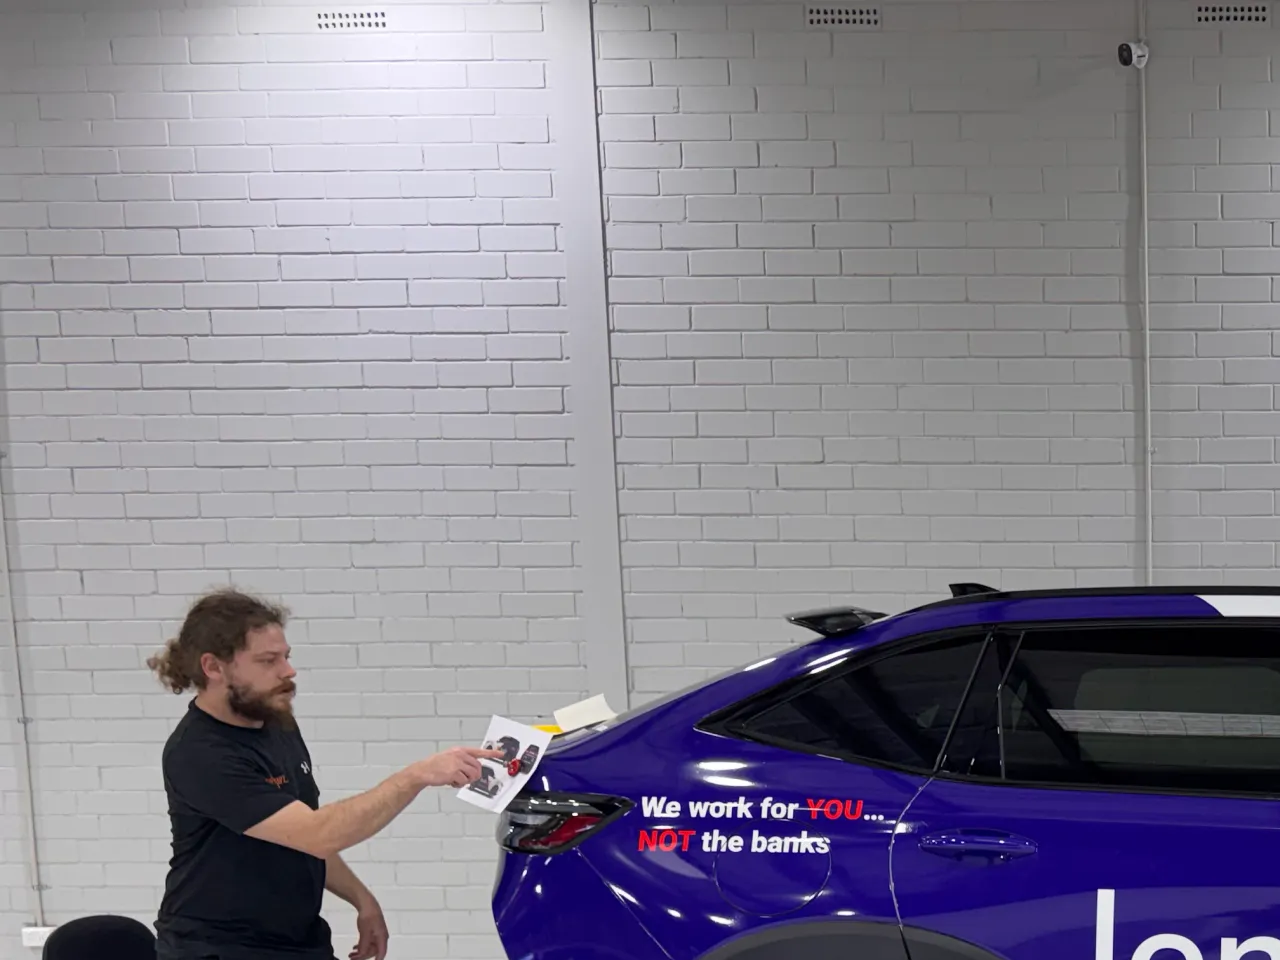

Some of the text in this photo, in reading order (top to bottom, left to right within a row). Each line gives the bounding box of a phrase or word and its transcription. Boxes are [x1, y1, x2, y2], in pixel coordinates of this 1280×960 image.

[641, 796, 885, 821] We work for YOU...
[638, 829, 831, 853] NOT the banks
